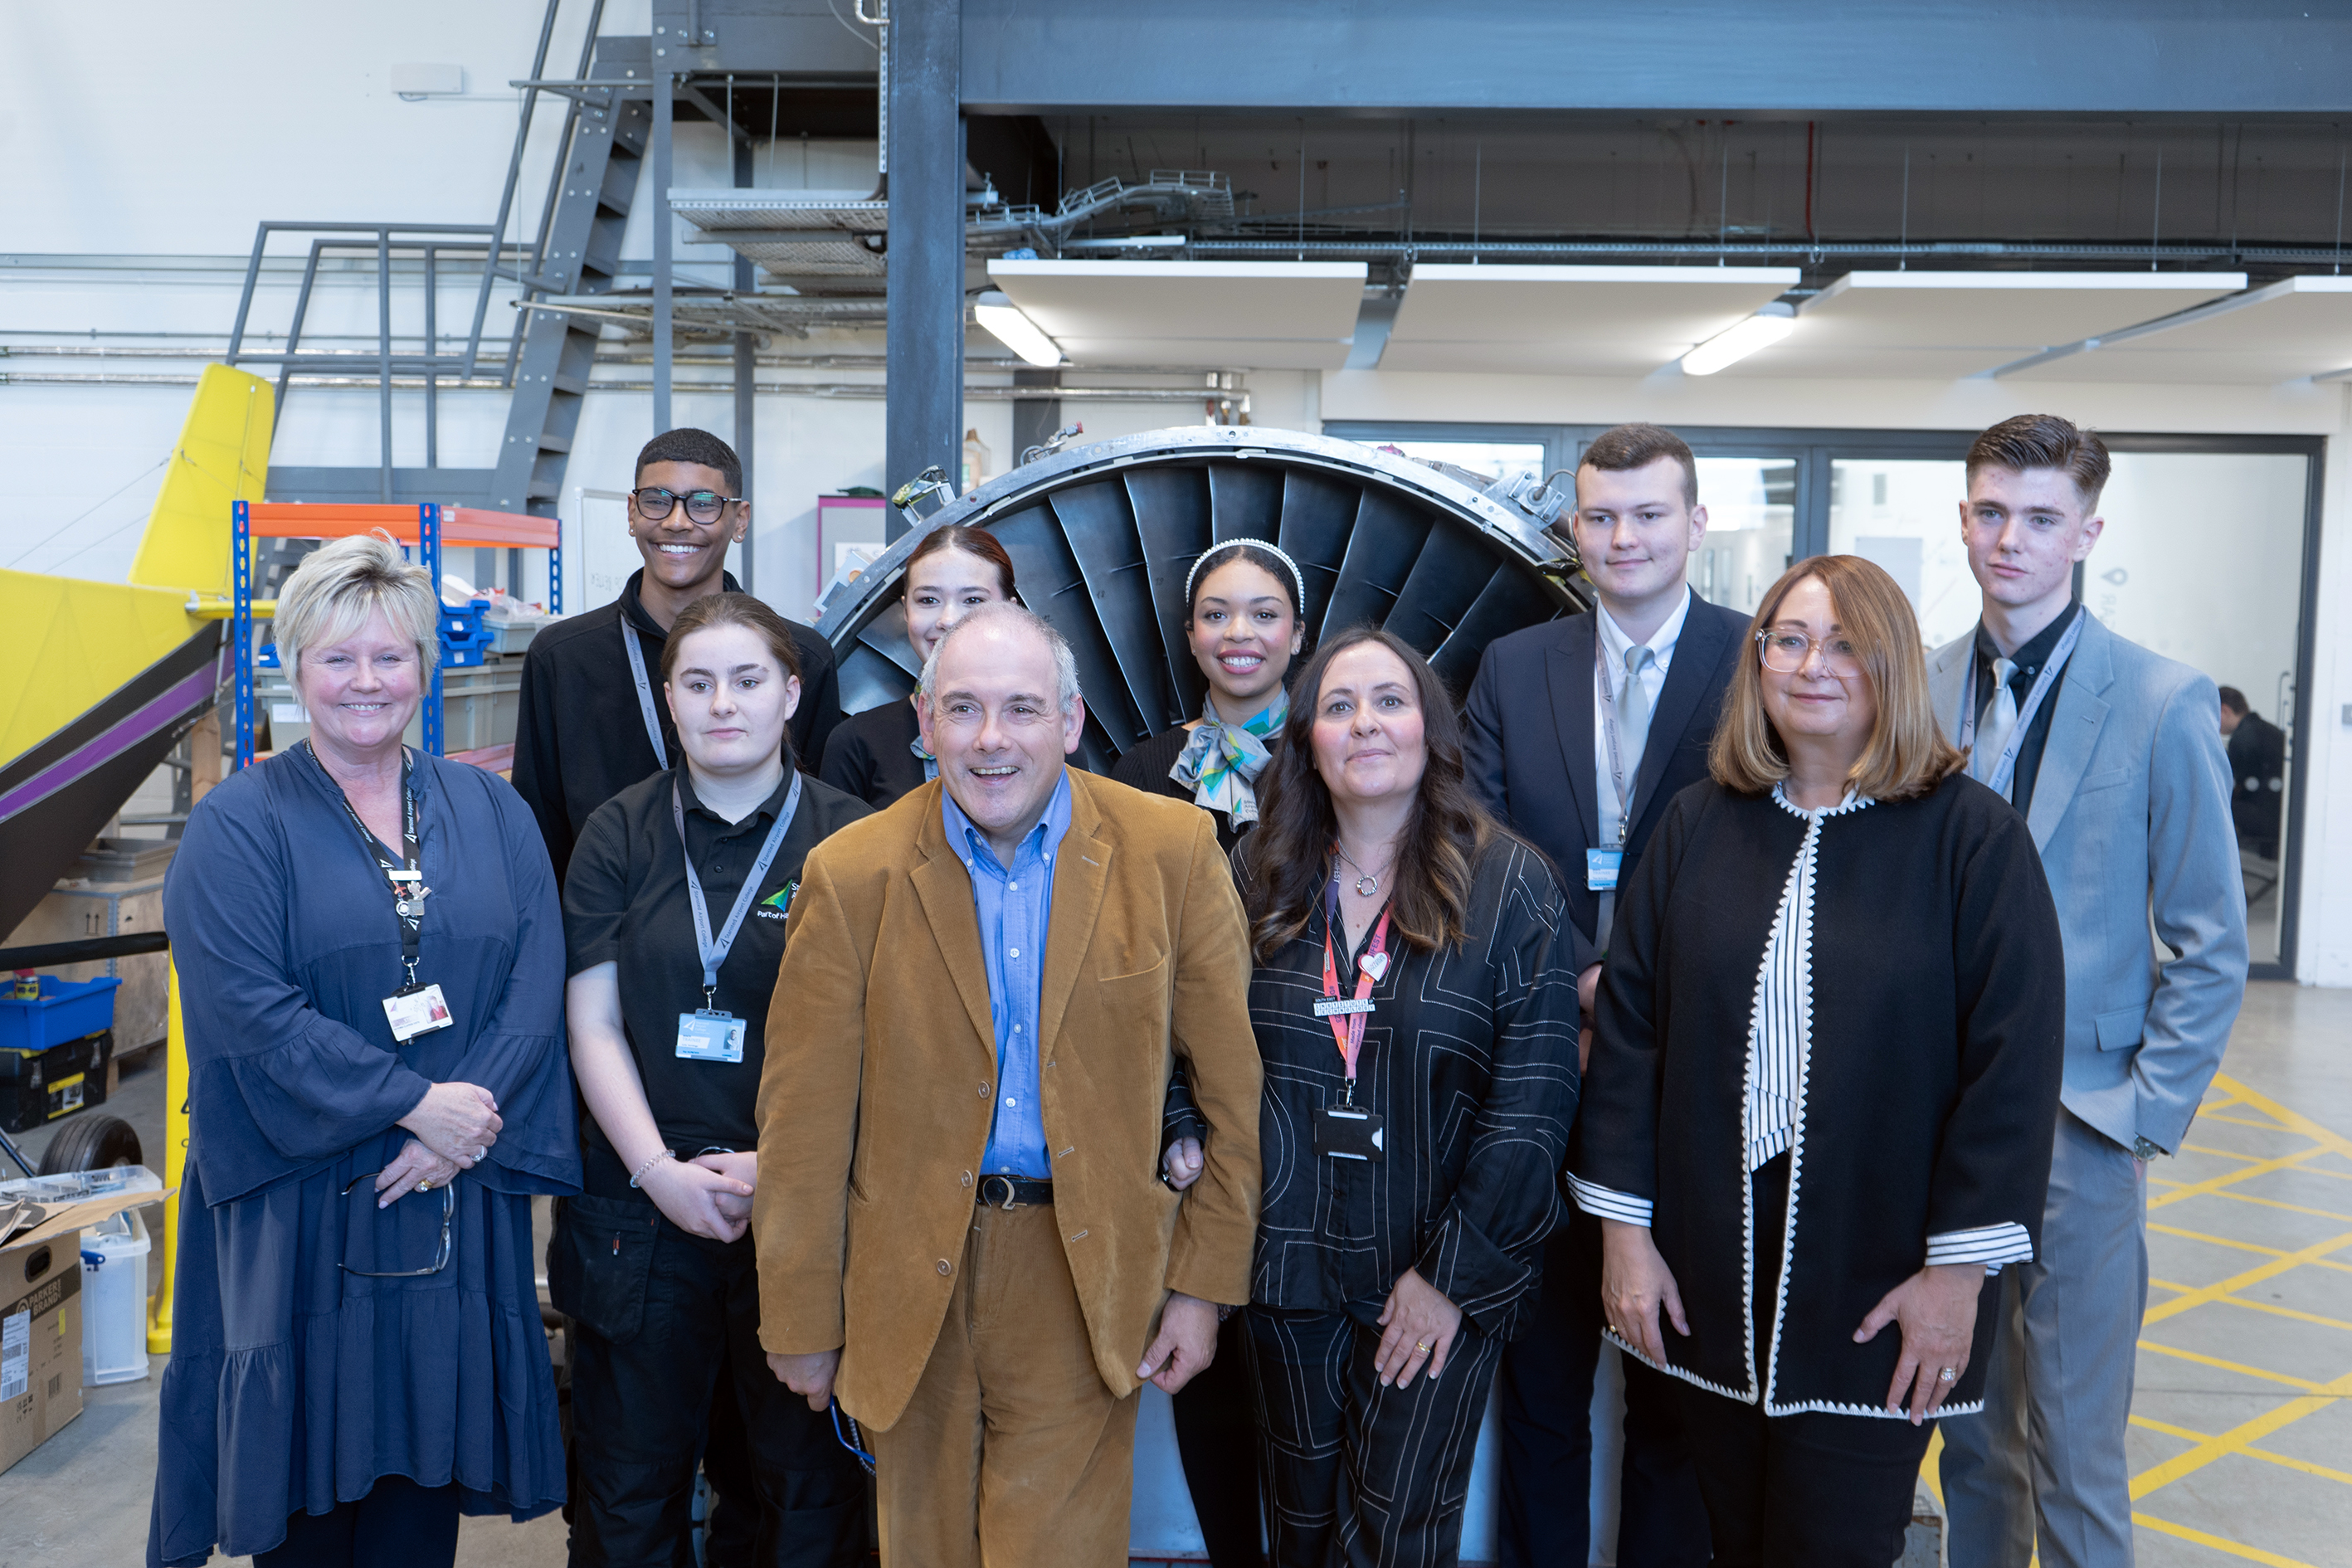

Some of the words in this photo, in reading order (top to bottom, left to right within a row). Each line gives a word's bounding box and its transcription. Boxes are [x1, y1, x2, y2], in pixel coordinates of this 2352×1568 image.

[350, 812, 363, 828] Airport
[360, 827, 373, 844] College
[407, 816, 415, 835] Stansted
[762, 842, 775, 862] Stansted
[772, 825, 782, 843] Airport
[779, 811, 790, 828] College
[694, 891, 703, 911] Stansted
[724, 919, 738, 939] Stansted
[734, 903, 746, 919] Airport
[743, 885, 754, 903] College
[1315, 1000, 1367, 1010] INSTITUTE
[1316, 1005, 1375, 1015] TECHNOLOGY
[29, 1280, 59, 1307] PARKER
[33, 1292, 59, 1317] BRAND
